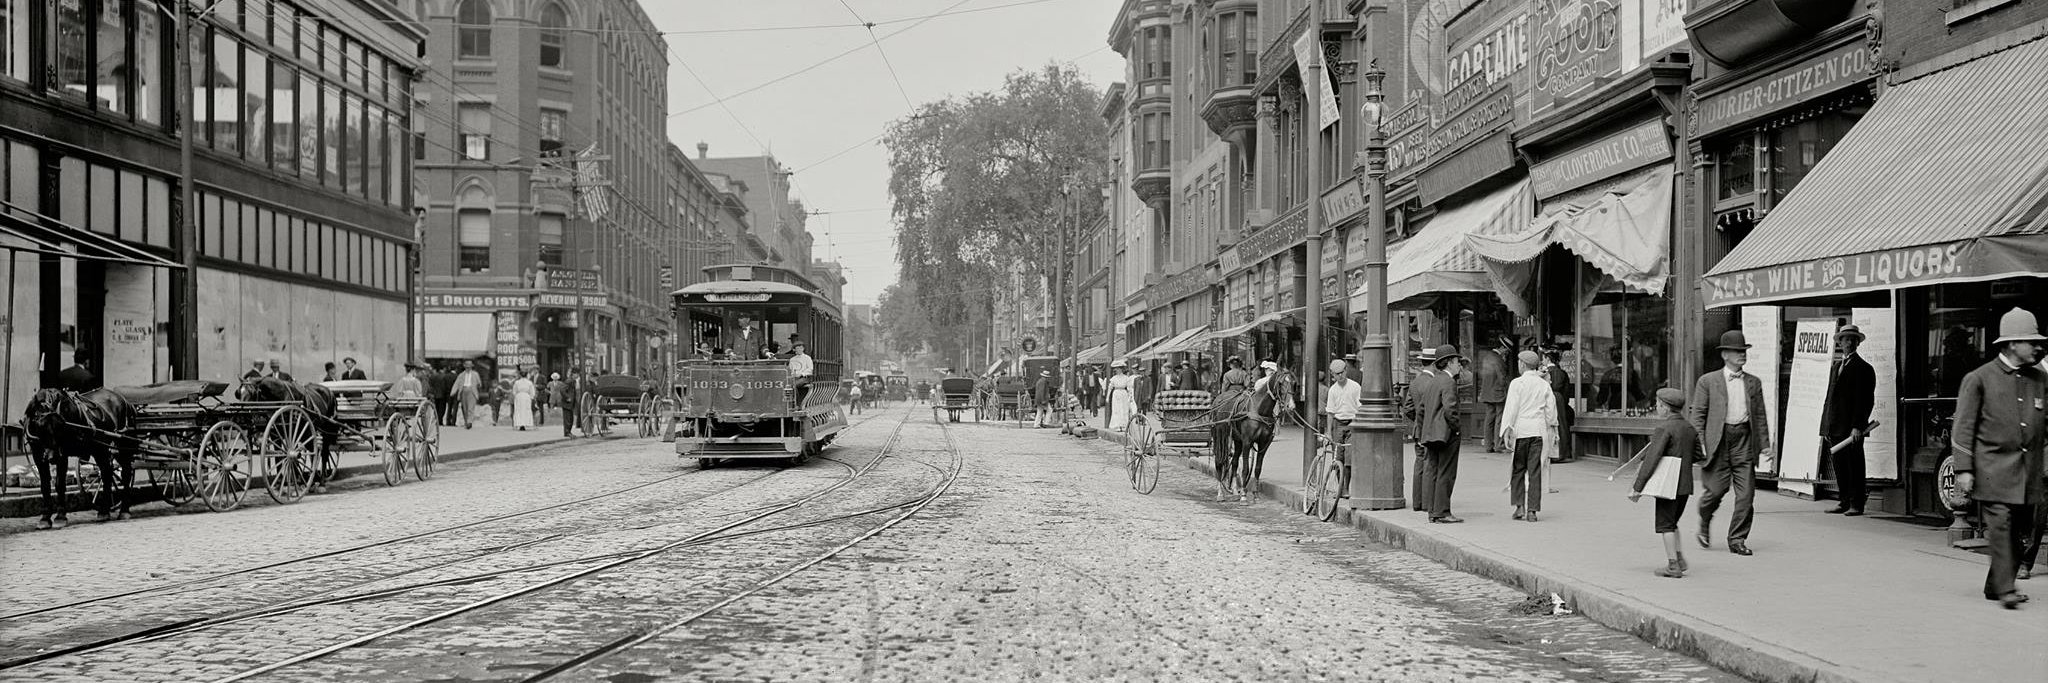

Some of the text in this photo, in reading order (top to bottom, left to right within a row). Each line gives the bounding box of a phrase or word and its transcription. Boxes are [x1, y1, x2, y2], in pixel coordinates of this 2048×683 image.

[1551, 54, 1599, 95] COMPANY
[1700, 56, 1838, 126] COURIER-CITIZEN
[1561, 141, 1623, 182] CLOVERDALE
[1623, 135, 1643, 161] CO.
[1559, 228, 1663, 292] COFFE
[1711, 244, 1962, 301] ALES, WINE AND LIQUORS.
[443, 294, 529, 307] DRUGGISTS.
[541, 294, 562, 305] NEVER
[497, 343, 518, 353] ROOT
[1798, 332, 1829, 354] SPECIAL
[497, 355, 518, 365] BEER
[518, 354, 536, 363] SODA
[747, 380, 785, 390] 1093
